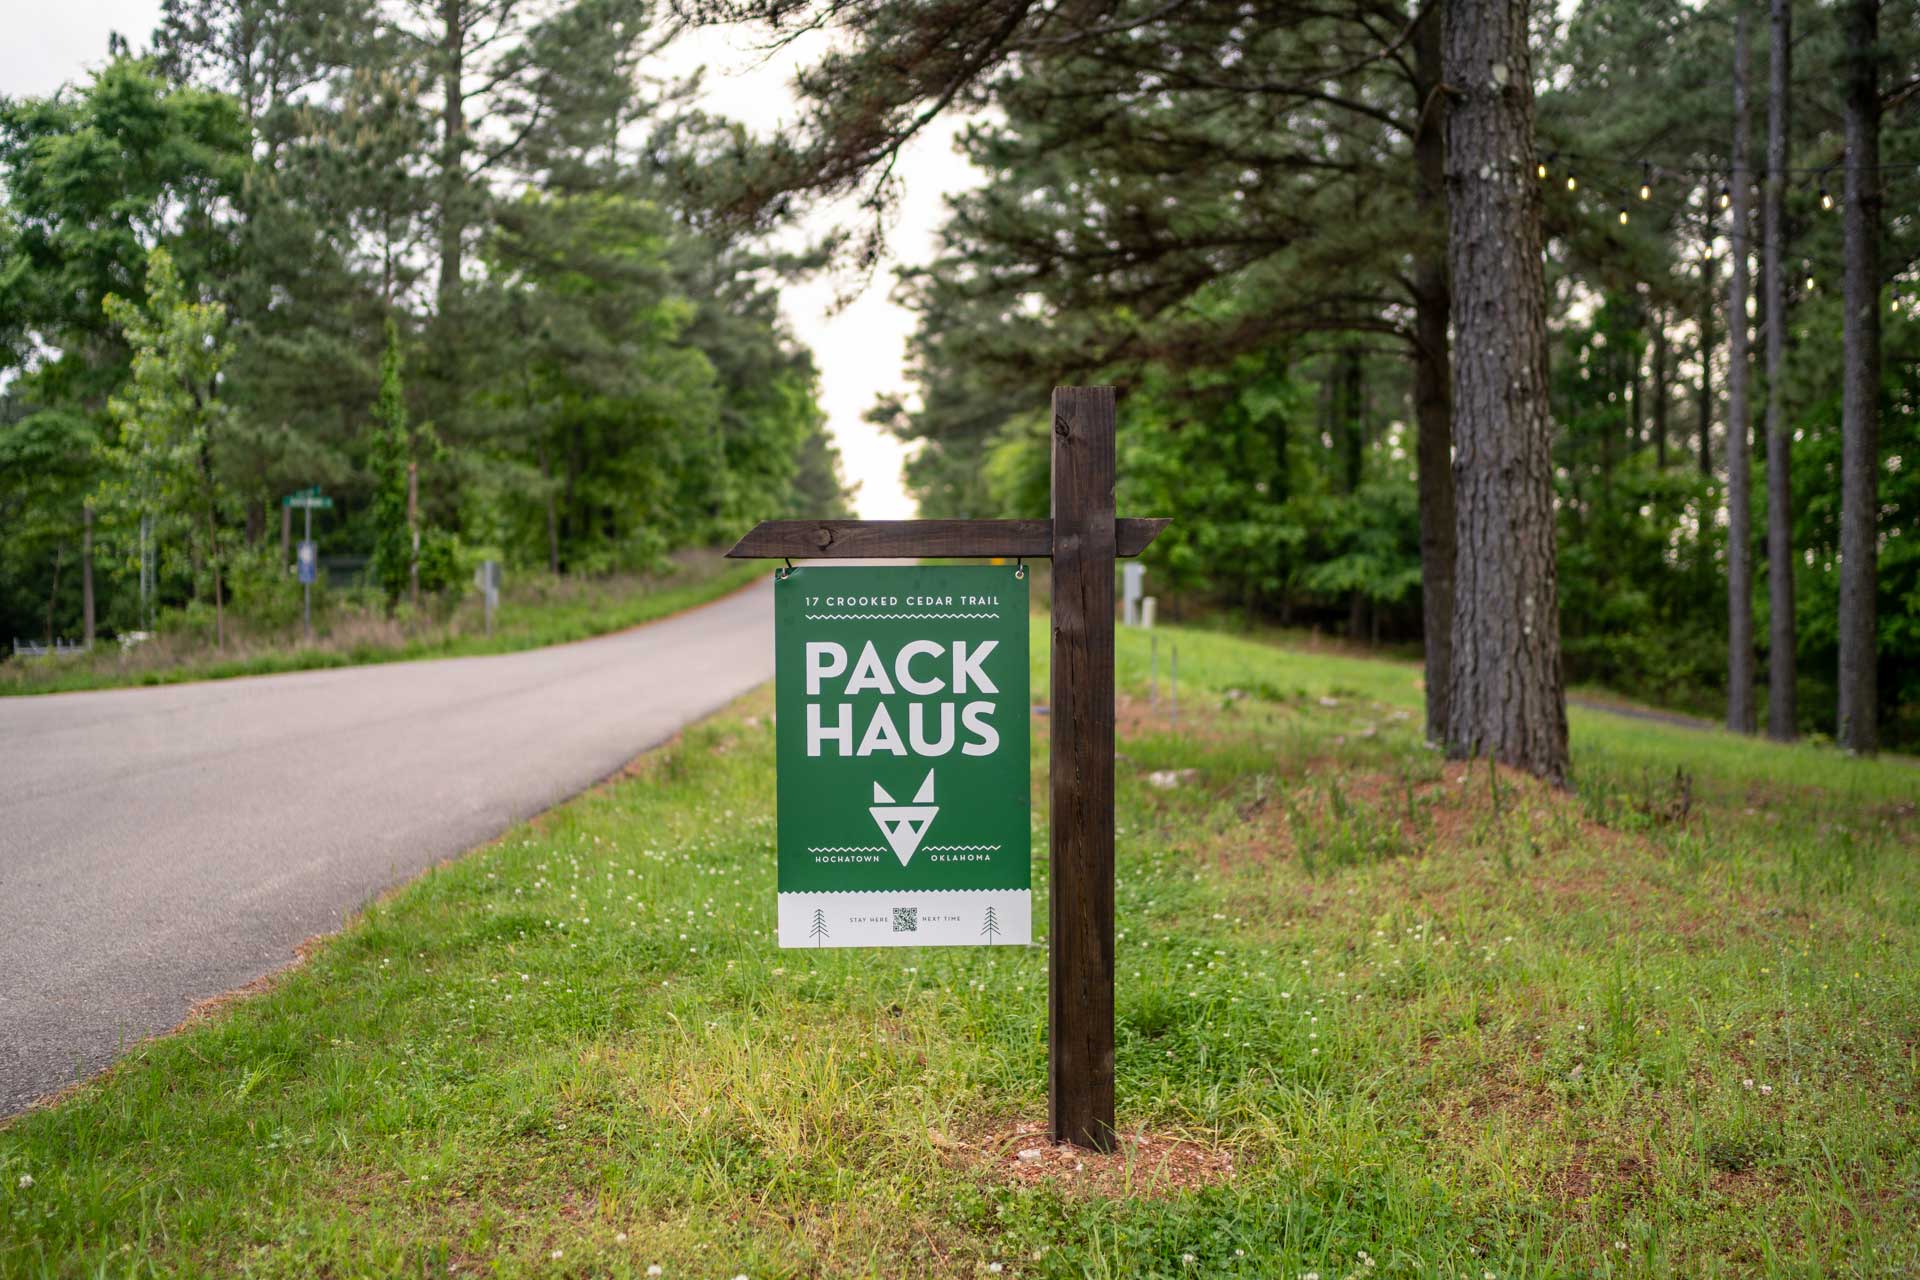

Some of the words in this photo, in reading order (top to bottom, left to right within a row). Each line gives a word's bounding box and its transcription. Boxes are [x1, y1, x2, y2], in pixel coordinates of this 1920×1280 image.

[805, 597, 819, 606] 17
[826, 596, 898, 606] CROOKED
[906, 596, 953, 605] CEDAR
[960, 595, 1000, 605] TRAIL
[806, 640, 1000, 695] PACK
[806, 701, 1000, 757] HAUS
[815, 855, 880, 863] HOCHATOWN
[931, 853, 991, 862] OKLAHOMA
